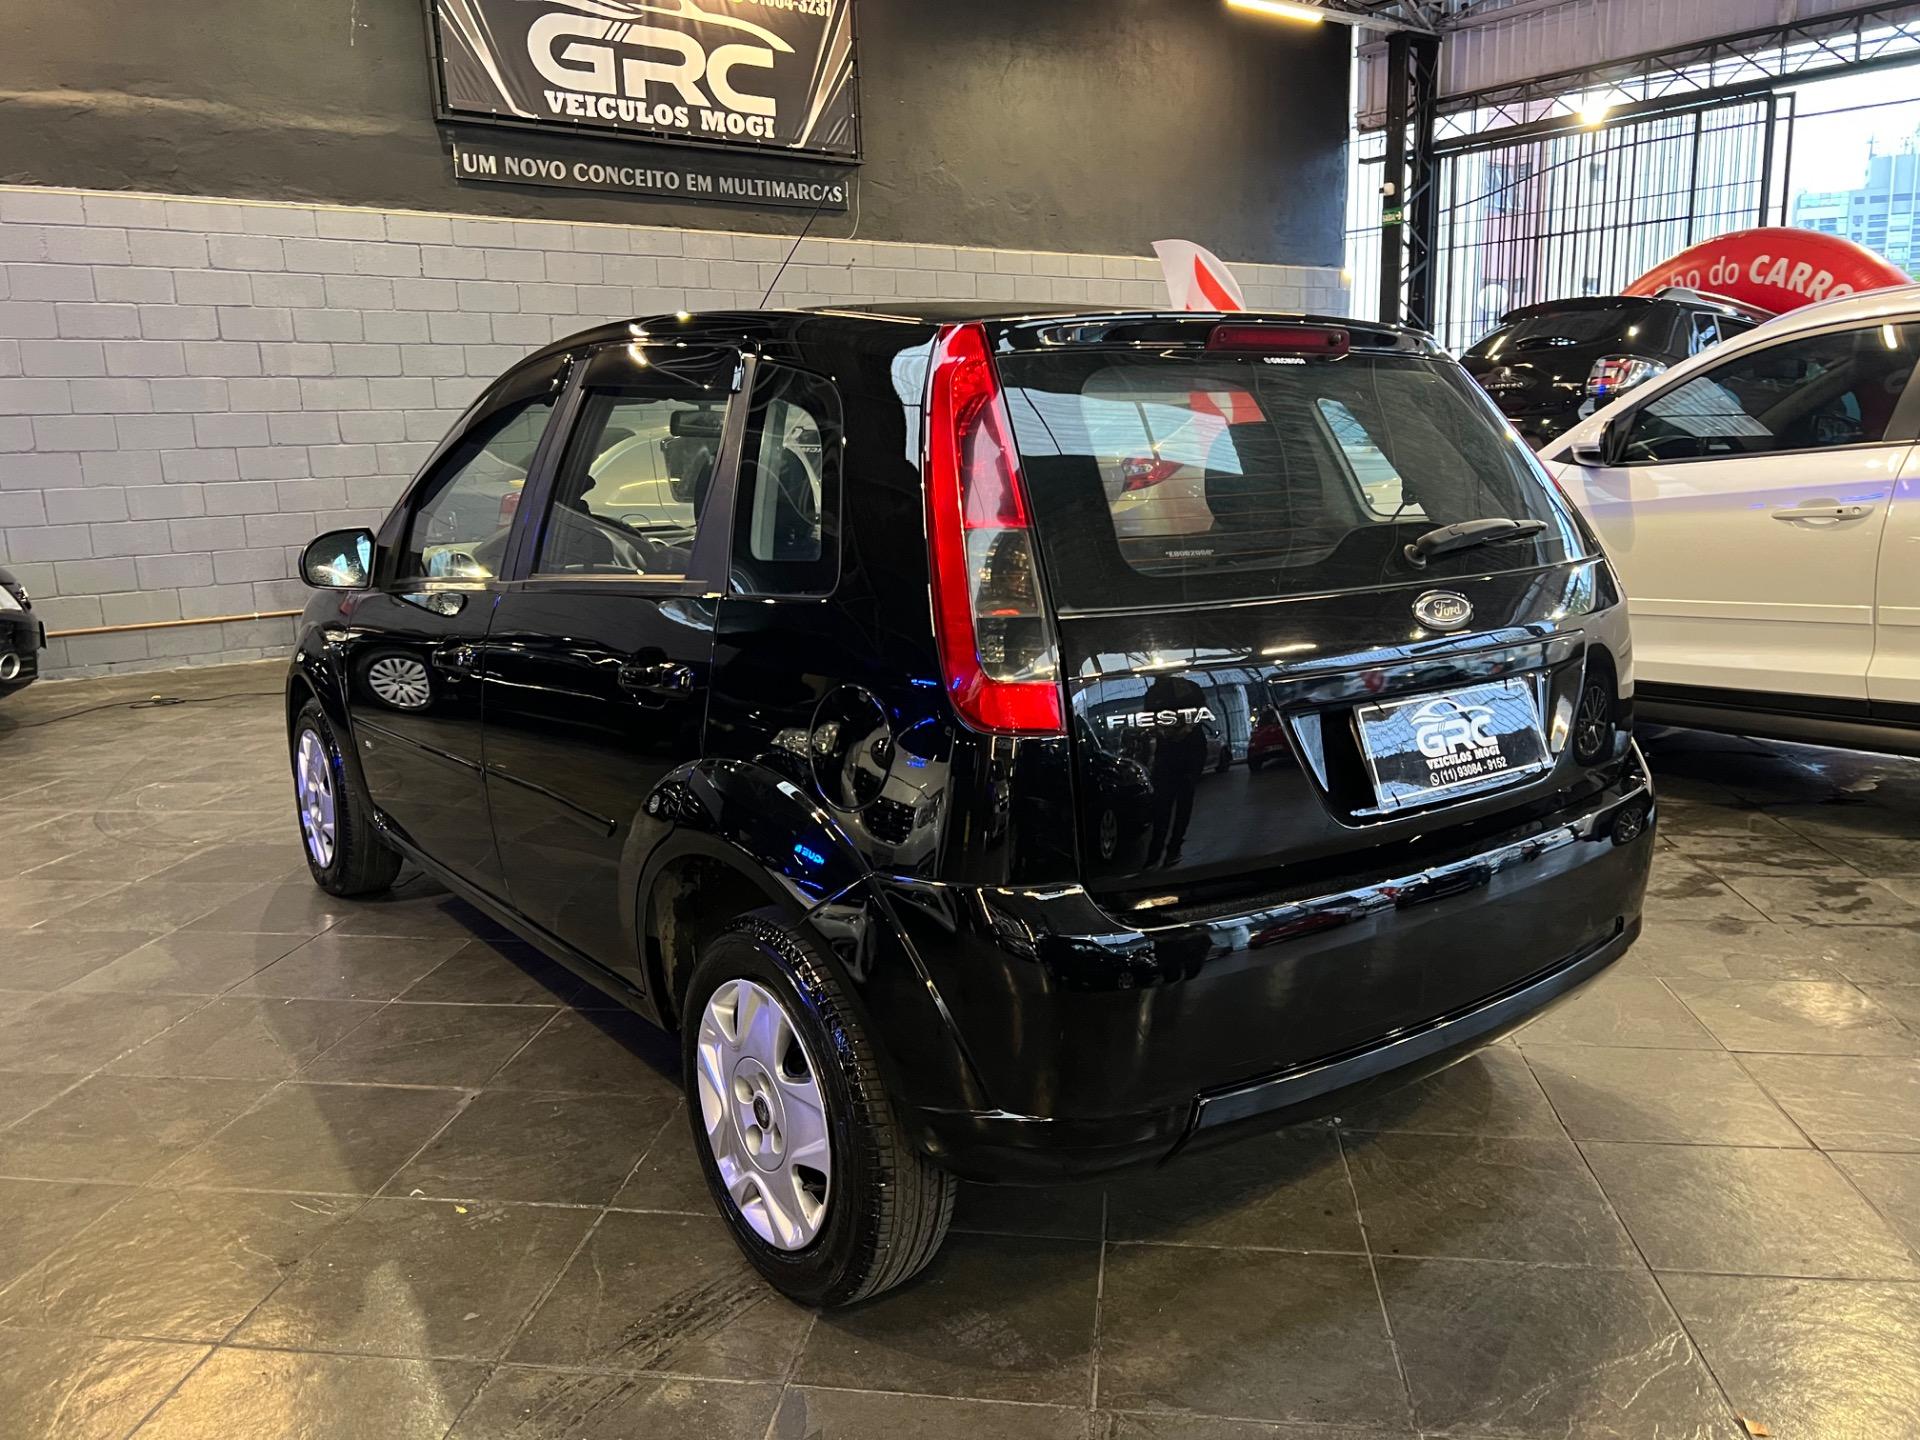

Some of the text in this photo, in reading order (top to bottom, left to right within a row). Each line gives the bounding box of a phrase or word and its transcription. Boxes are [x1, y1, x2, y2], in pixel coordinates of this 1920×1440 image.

[527, 12, 777, 118] GRC
[543, 90, 776, 139] VEICULOS MOGI
[462, 153, 843, 203] UM NOVO CONCEITO EM MULTIMARCAS
[1655, 270, 1700, 290] ho
[1708, 256, 1740, 286] do
[1434, 599, 1463, 618] Ford
[1106, 706, 1217, 730] FIESTA
[1416, 714, 1499, 758] GRC
[1426, 744, 1501, 770] VEICULOS MOGI
[1440, 768, 1458, 785] (11)
[1487, 756, 1508, 771] 9152
